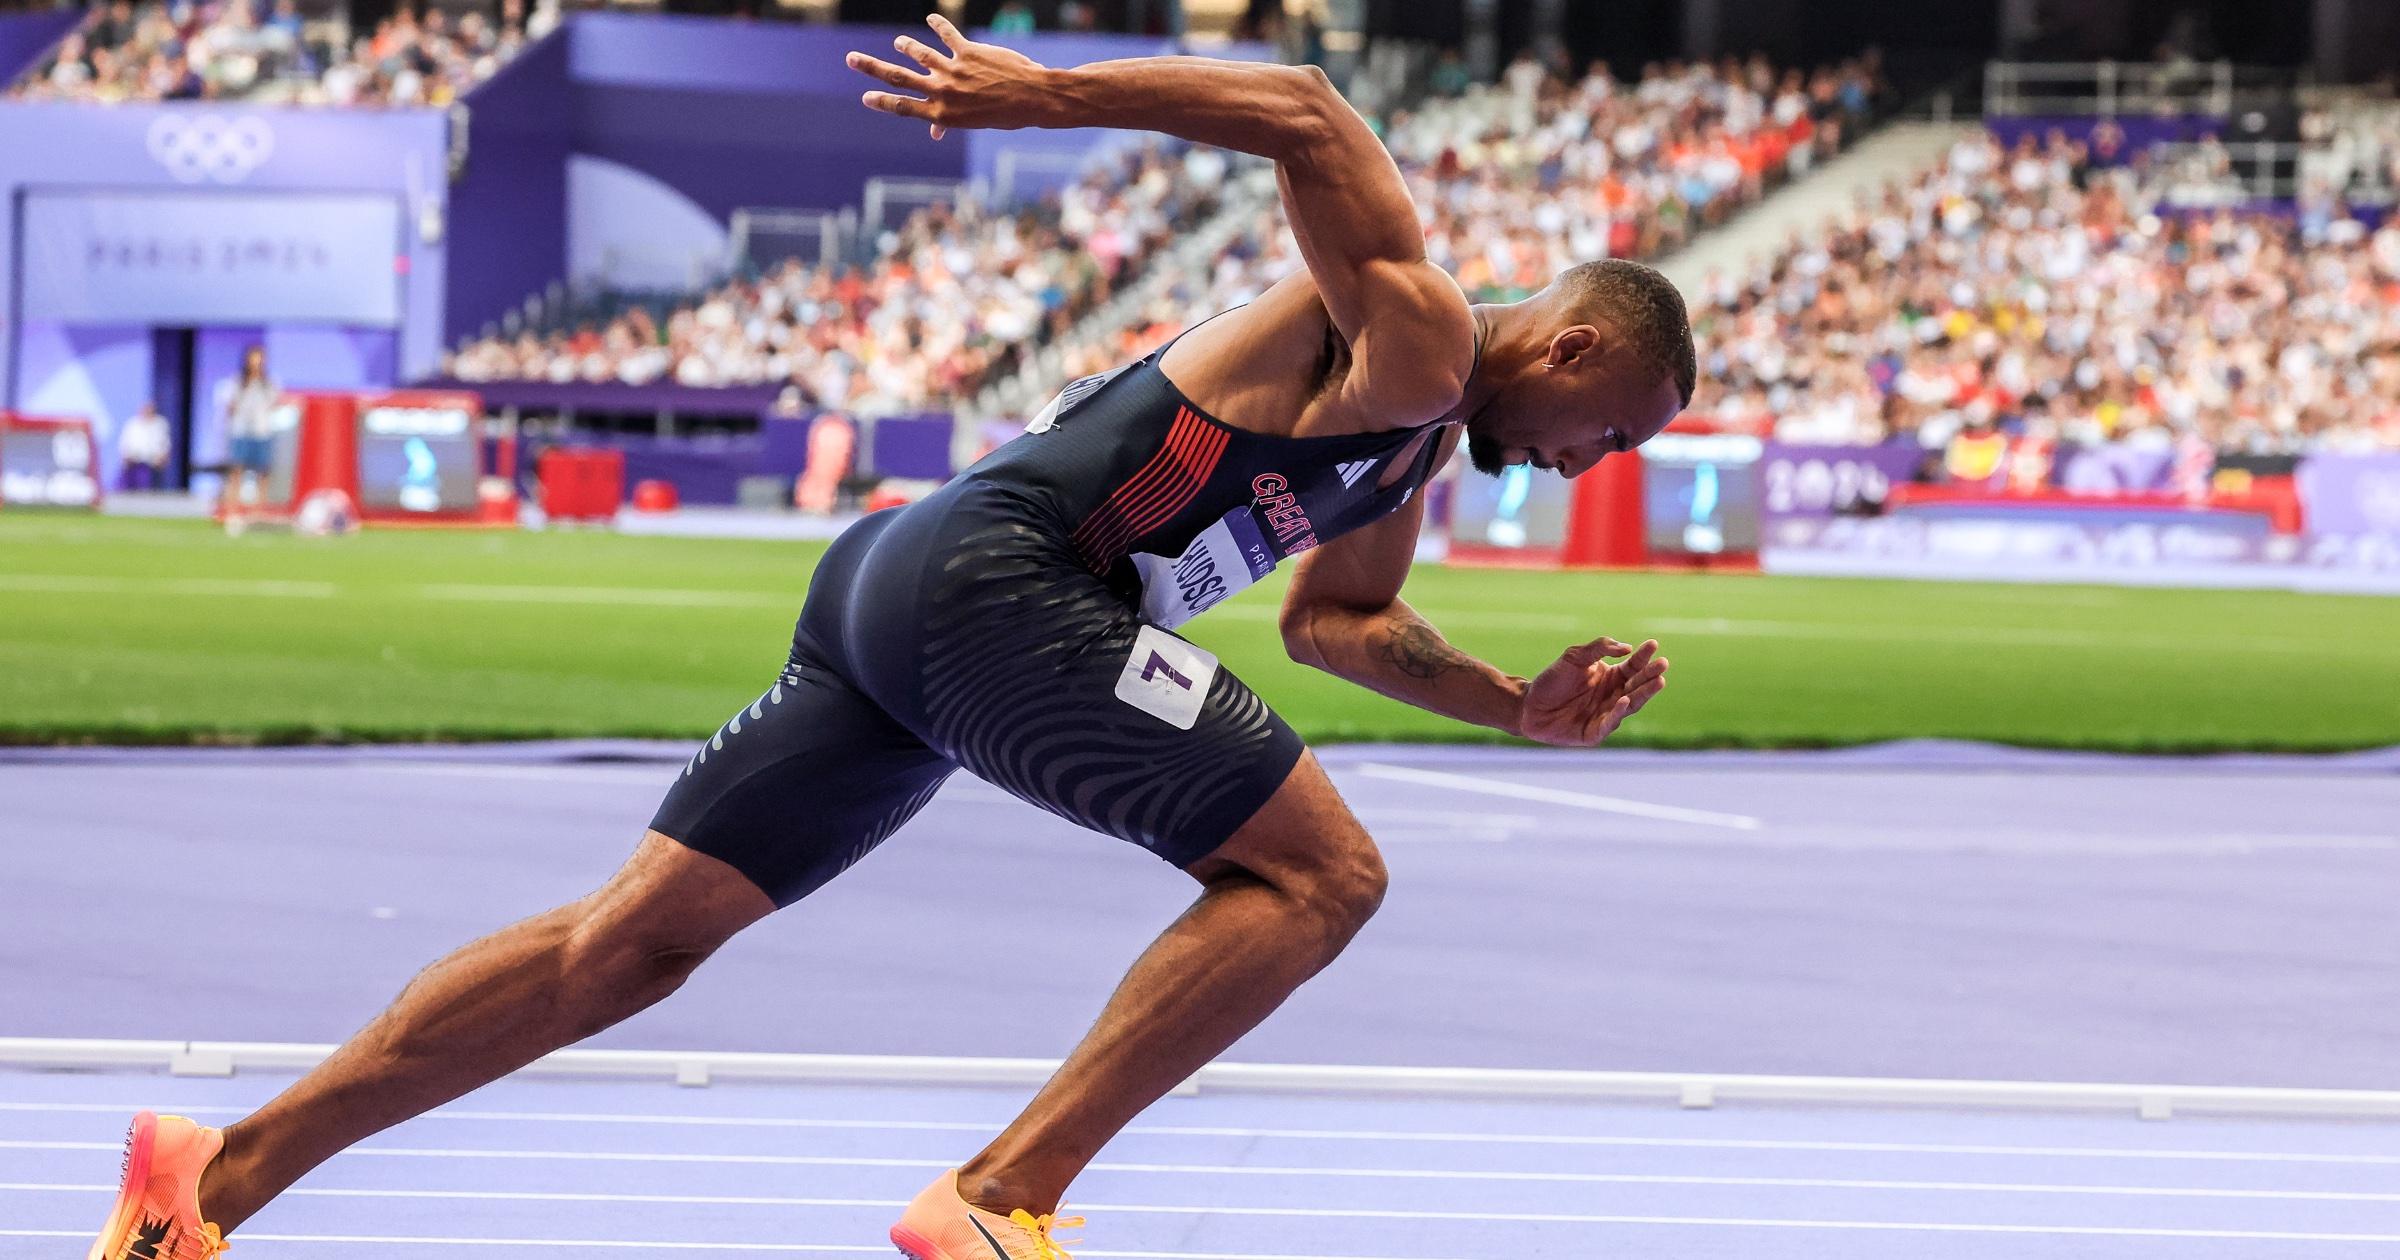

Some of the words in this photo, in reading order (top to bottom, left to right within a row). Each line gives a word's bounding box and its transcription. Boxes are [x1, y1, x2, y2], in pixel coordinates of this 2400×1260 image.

[1252, 473, 1312, 543] GREAT
[1766, 458, 1888, 513] 2024
[1141, 649, 1193, 691] 7
